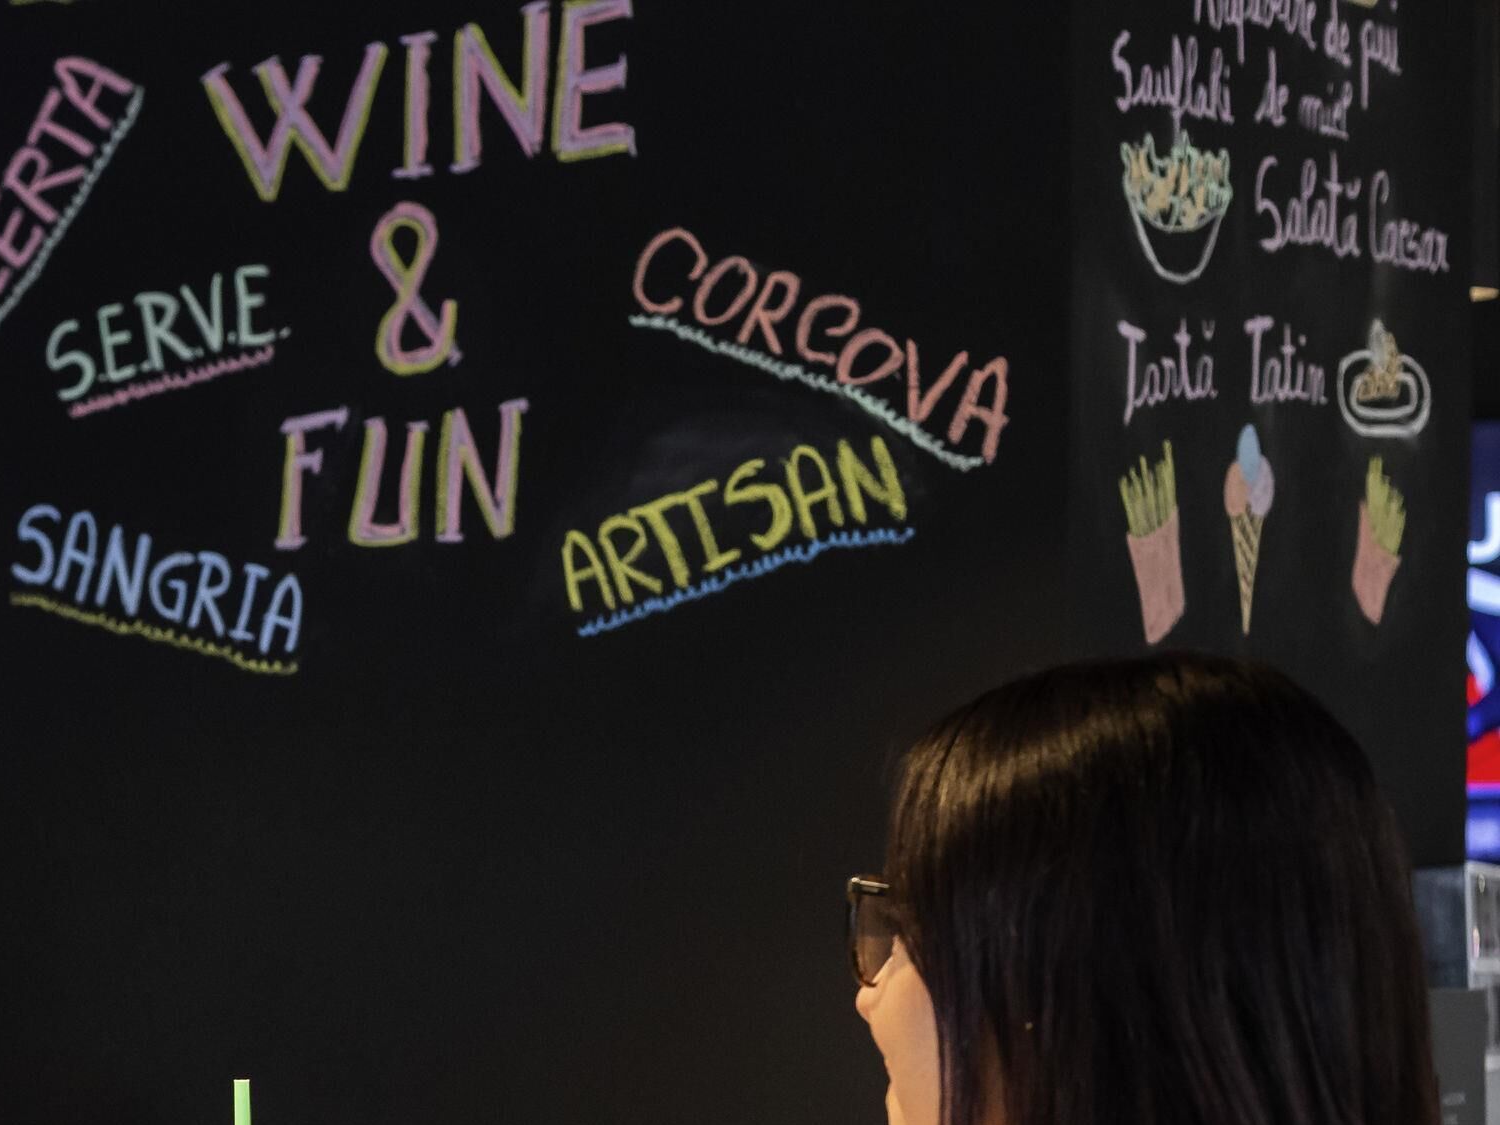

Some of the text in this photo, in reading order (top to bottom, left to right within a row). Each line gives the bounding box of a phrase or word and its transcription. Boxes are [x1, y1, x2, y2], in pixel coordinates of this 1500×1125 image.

[202, 0, 636, 202] WINE
[1253, 46, 1290, 127] de
[1255, 149, 1362, 260] Salată
[370, 201, 462, 376] &
[632, 226, 1011, 465] CORCOVA
[1116, 315, 1329, 427] Tartă Tatin
[275, 399, 529, 550] FUN
[561, 436, 908, 613] ARTISAN
[11, 504, 302, 653] SANGRIA
